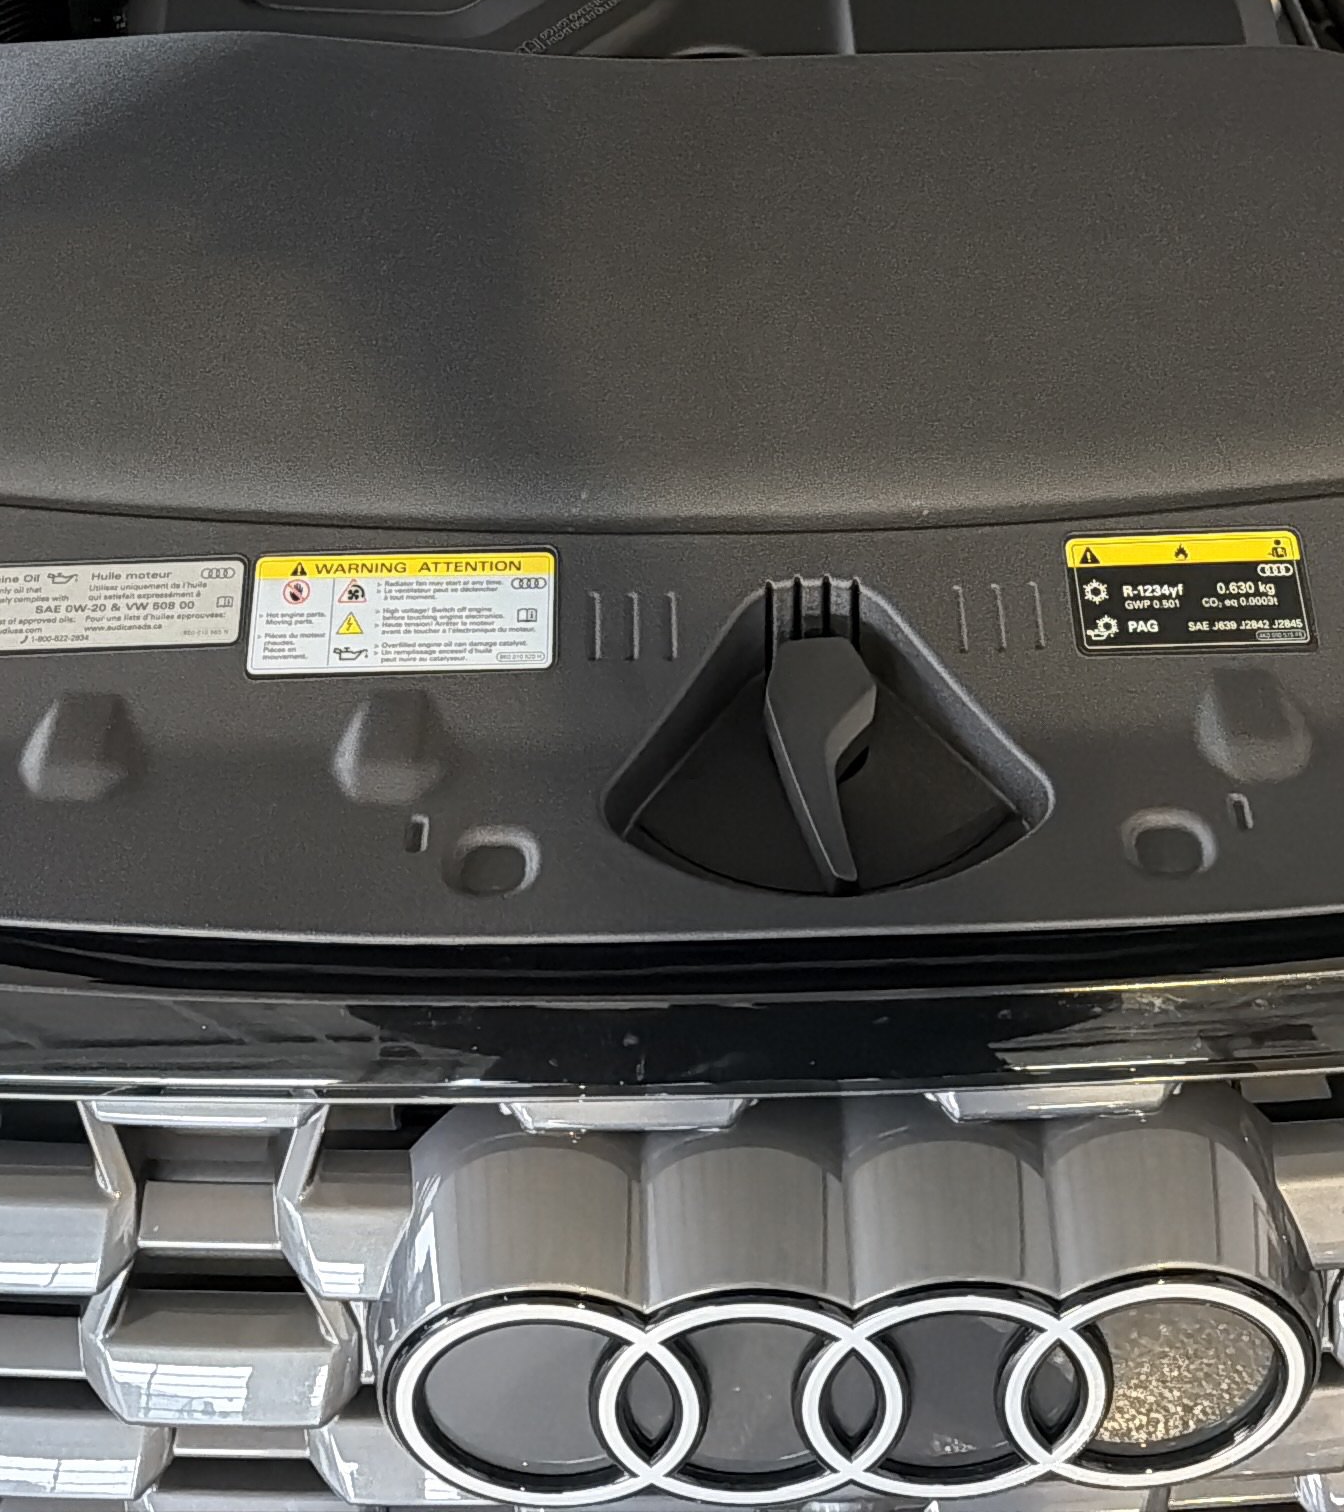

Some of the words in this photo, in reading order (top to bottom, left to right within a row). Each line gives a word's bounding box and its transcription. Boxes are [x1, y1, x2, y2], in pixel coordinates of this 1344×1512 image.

[316, 562, 406, 574] WARNING
[418, 560, 522, 572] ATTENTION
[24, 574, 40, 583] Oil
[92, 572, 121, 581] Huile
[126, 571, 172, 580] moteur
[1122, 584, 1184, 598] R-1234yf
[1216, 582, 1254, 595] 0.630
[1258, 581, 1275, 596] kg
[35, 605, 61, 614] SAE
[65, 604, 106, 613] 0W-20
[111, 603, 120, 612] &
[126, 602, 149, 611] VW
[179, 601, 194, 609] 00
[1125, 600, 1150, 610] GWP
[1153, 599, 1180, 608] 0.501
[1225, 599, 1238, 608] eq
[1240, 597, 1278, 607] 0.0003t
[1128, 620, 1159, 633] PAG
[1188, 622, 1209, 631] SAE
[1213, 621, 1237, 630] J639
[1240, 620, 1269, 629] J2842
[1273, 619, 1303, 629] J2845
